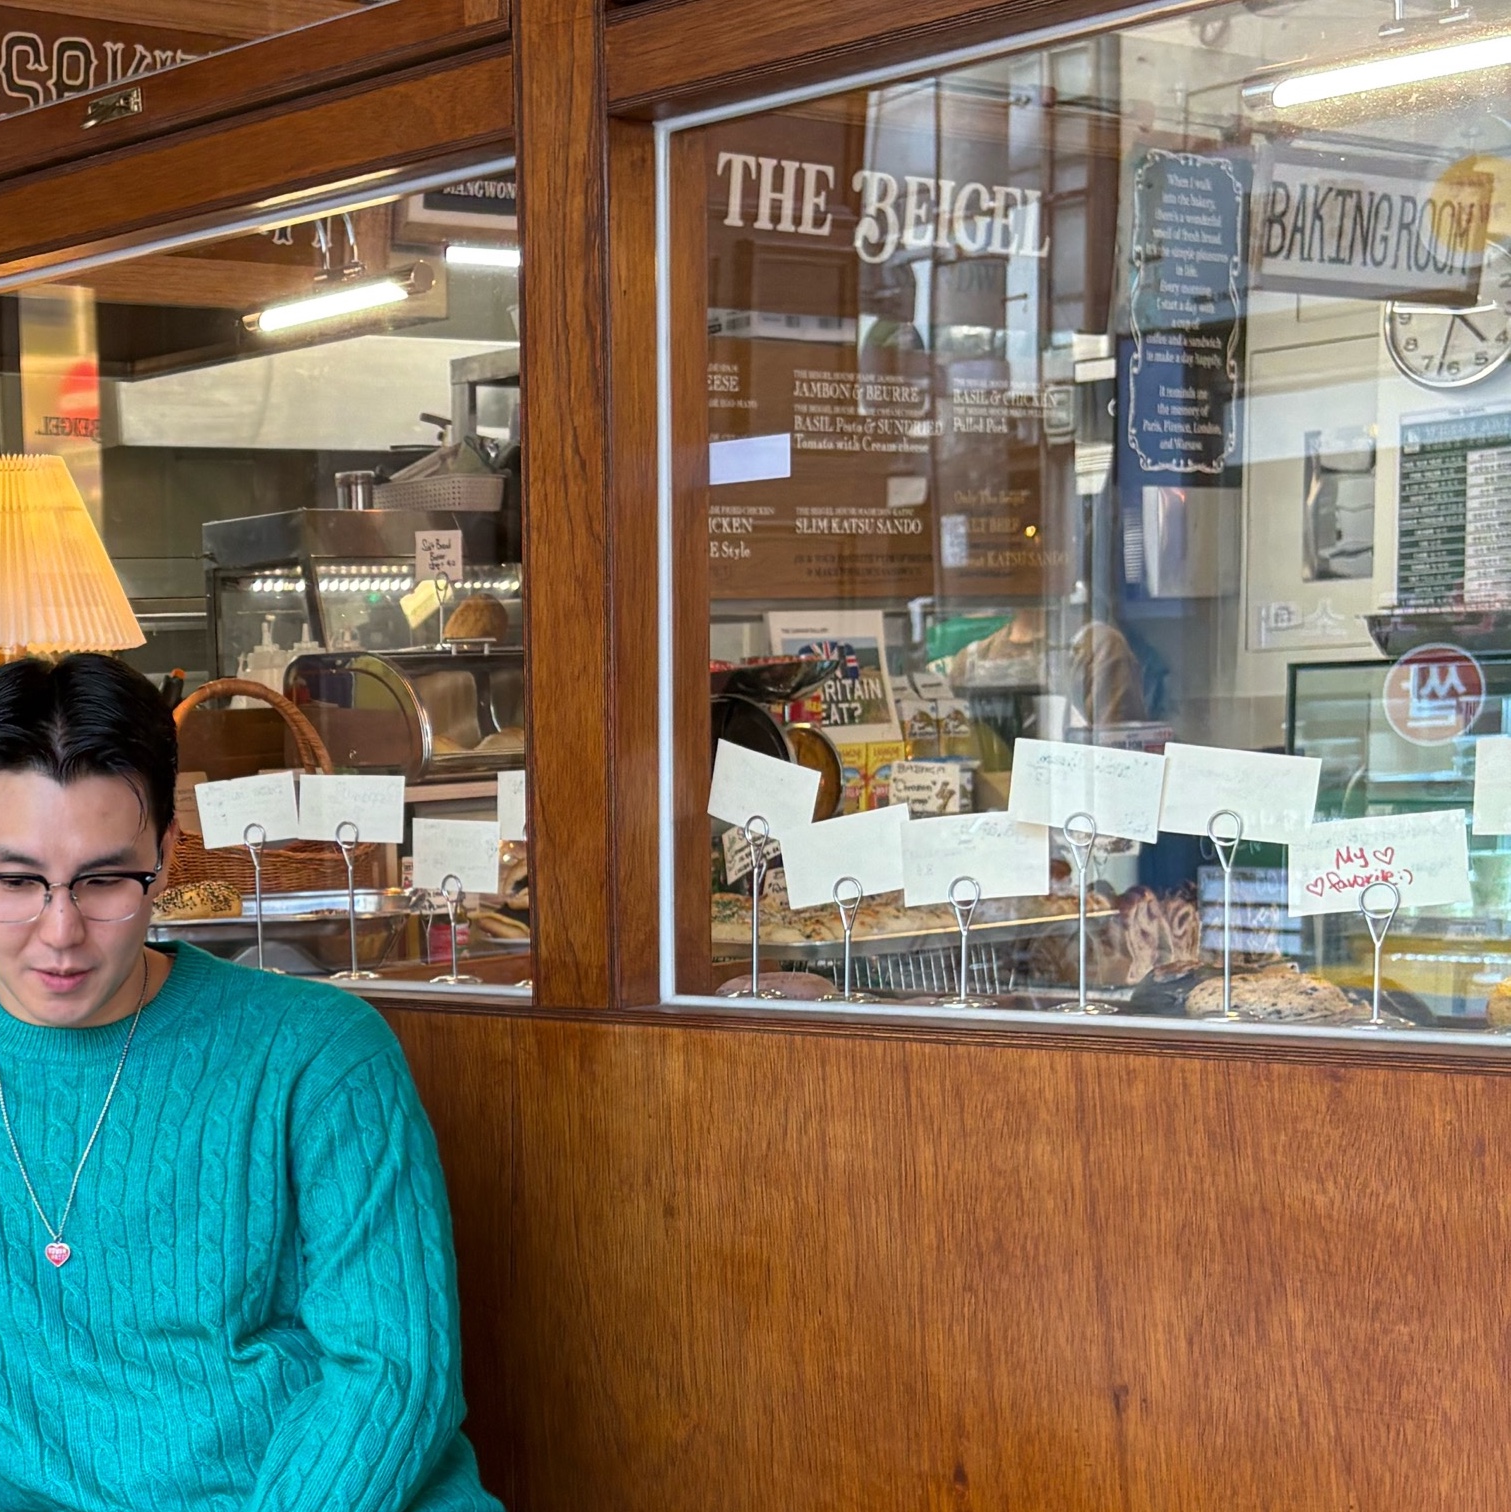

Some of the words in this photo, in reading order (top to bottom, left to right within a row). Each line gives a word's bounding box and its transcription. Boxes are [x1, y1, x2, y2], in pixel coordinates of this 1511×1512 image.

[717, 152, 835, 236] THE
[852, 170, 1050, 264] BEIGEL
[1263, 181, 1393, 268] BAKING
[1391, 195, 1475, 276] ROOM
[1168, 333, 1183, 347] and
[1403, 337, 1418, 352] 8
[1495, 329, 1509, 345] 4
[1422, 355, 1434, 371] 7
[1474, 350, 1489, 366] 5
[1446, 361, 1460, 376] 6
[793, 380, 852, 400] JAMBON
[866, 384, 920, 403] BEURRE
[953, 389, 988, 405] BASIL
[1003, 390, 1058, 408] CHICKEN
[794, 415, 834, 432] BASIL
[864, 417, 876, 434] &
[877, 418, 944, 436] SUNDRIED
[953, 417, 983, 433] Pulled
[795, 433, 834, 450] Tomato
[836, 434, 860, 451] with
[862, 436, 894, 452] Cream
[1159, 437, 1174, 450] and
[795, 517, 829, 534] SLIM
[831, 518, 875, 534] KATSU
[875, 518, 923, 535] SANDO
[721, 541, 751, 560] Style
[821, 679, 883, 702] RITAIN
[822, 703, 863, 725] EAT?
[1335, 846, 1369, 869] My
